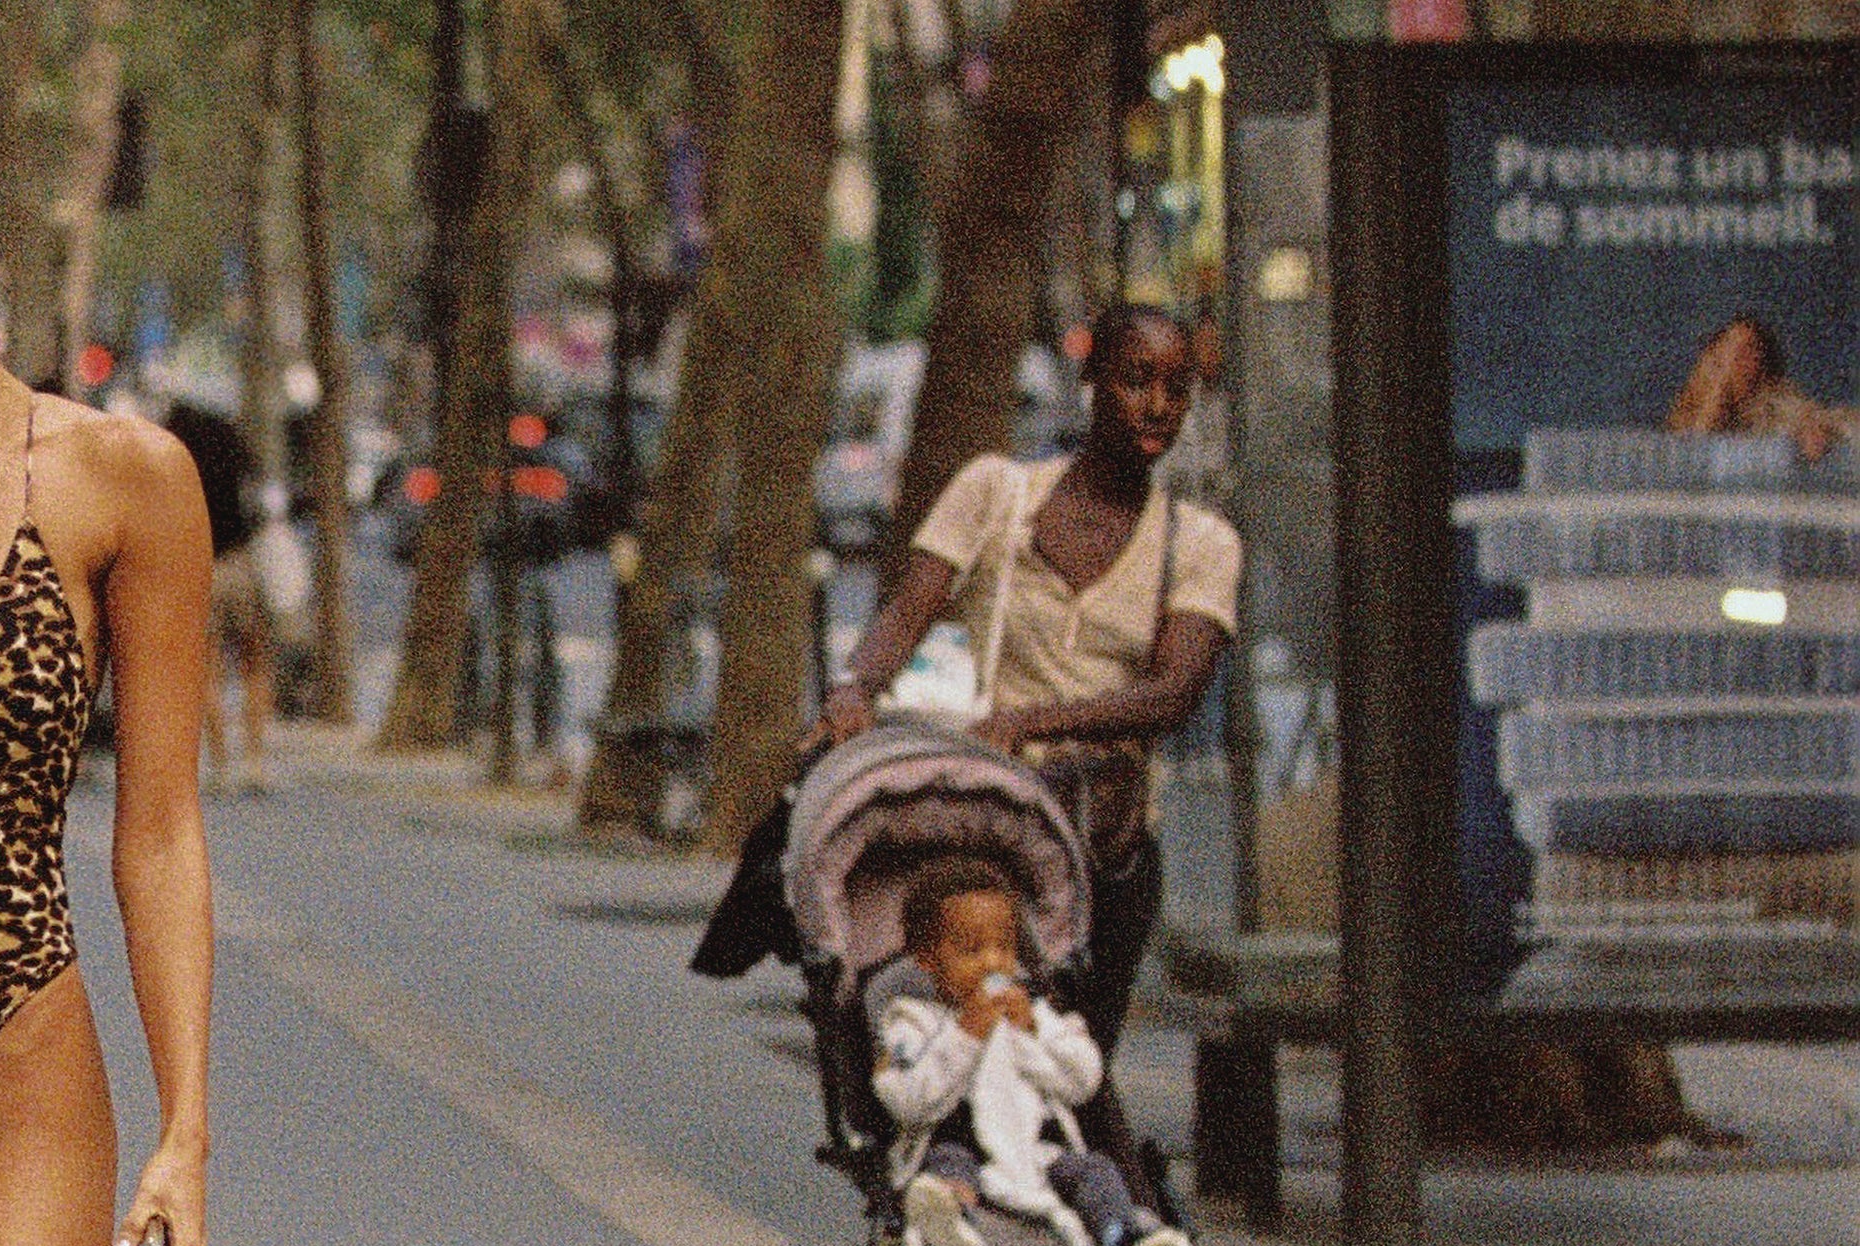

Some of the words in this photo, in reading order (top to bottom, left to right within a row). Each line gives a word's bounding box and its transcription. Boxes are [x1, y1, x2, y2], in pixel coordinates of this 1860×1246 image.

[1494, 137, 1681, 188] Prenez
[1692, 146, 1768, 188] un
[1780, 136, 1859, 188] ba
[1494, 193, 1564, 245] de
[1576, 193, 1836, 245] sommeil.
